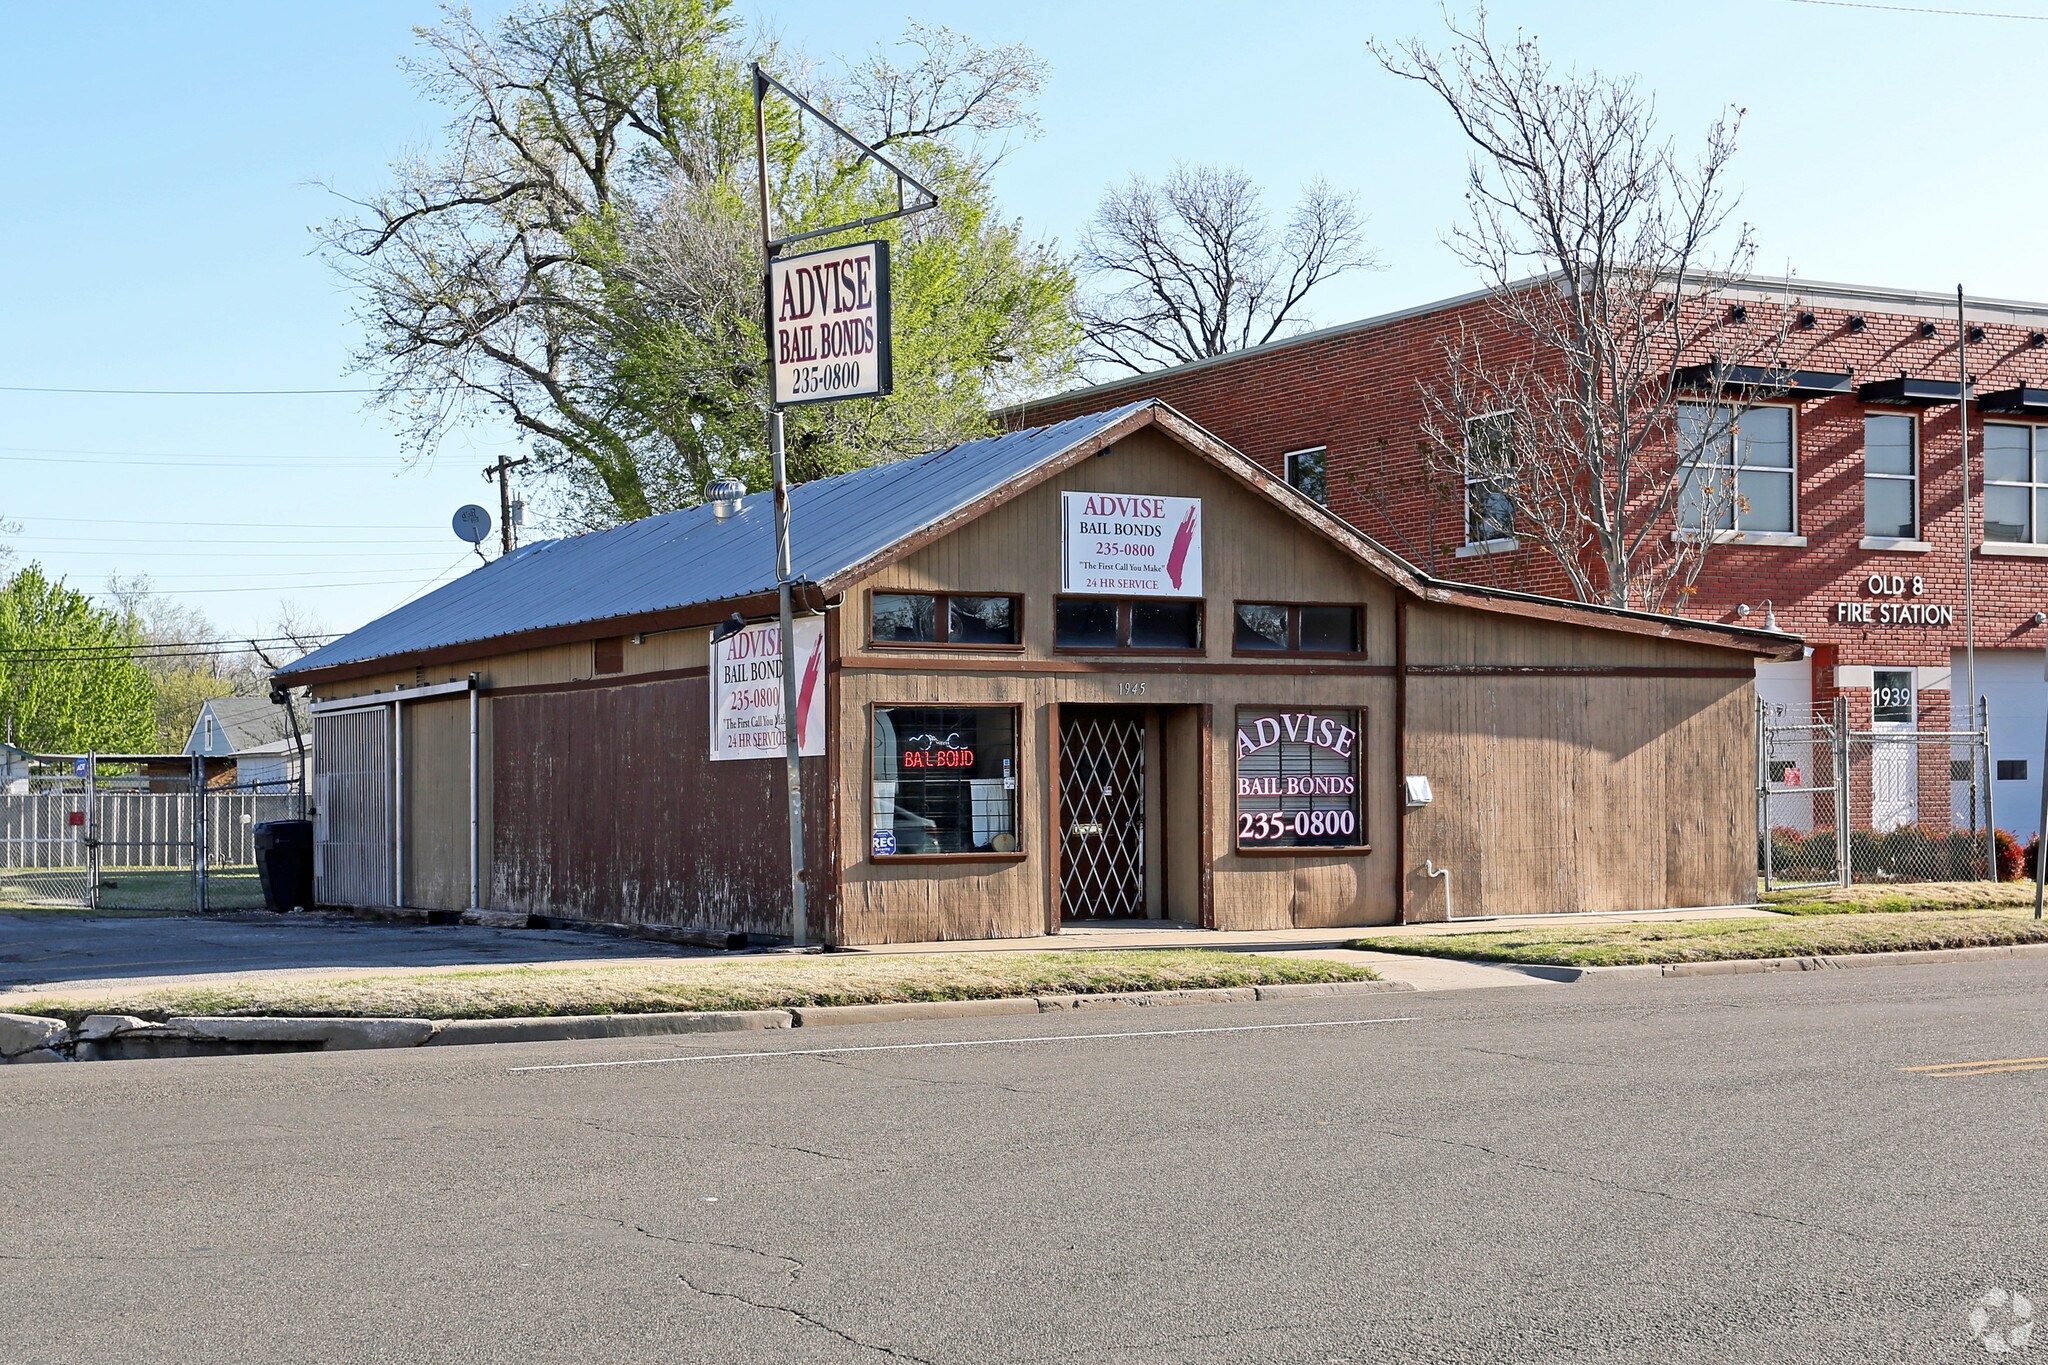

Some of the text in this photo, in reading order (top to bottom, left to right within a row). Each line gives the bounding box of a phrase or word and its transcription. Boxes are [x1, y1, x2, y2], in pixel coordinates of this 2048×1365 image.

[779, 256, 872, 322] ADVISE
[779, 316, 874, 364] BAIL BONDS
[792, 361, 860, 394] 235-0800
[1083, 496, 1166, 518] ADVISE
[1080, 522, 1161, 537] BAIL BONDS
[1096, 542, 1155, 557] 235-0800
[1080, 561, 1165, 573] "The First Call You Make"
[1086, 578, 1159, 589] 24 HR SERVICE
[1868, 575, 1923, 596] OLD 8
[1838, 603, 1953, 625] FIRE STATION
[724, 659, 784, 684] BAIL BOND
[731, 686, 779, 711] 235-0800
[1118, 682, 1146, 696] 1945
[1873, 688, 1910, 706] 1939
[737, 717, 750, 728] First
[751, 716, 762, 727] Call
[763, 715, 774, 726] You
[728, 731, 787, 748] 24 HR SERVICE
[1238, 713, 1356, 760] ADVISE
[1238, 776, 1355, 796] BAIL BONDS
[1239, 810, 1355, 839] 235-0800
[873, 837, 894, 848] REC
